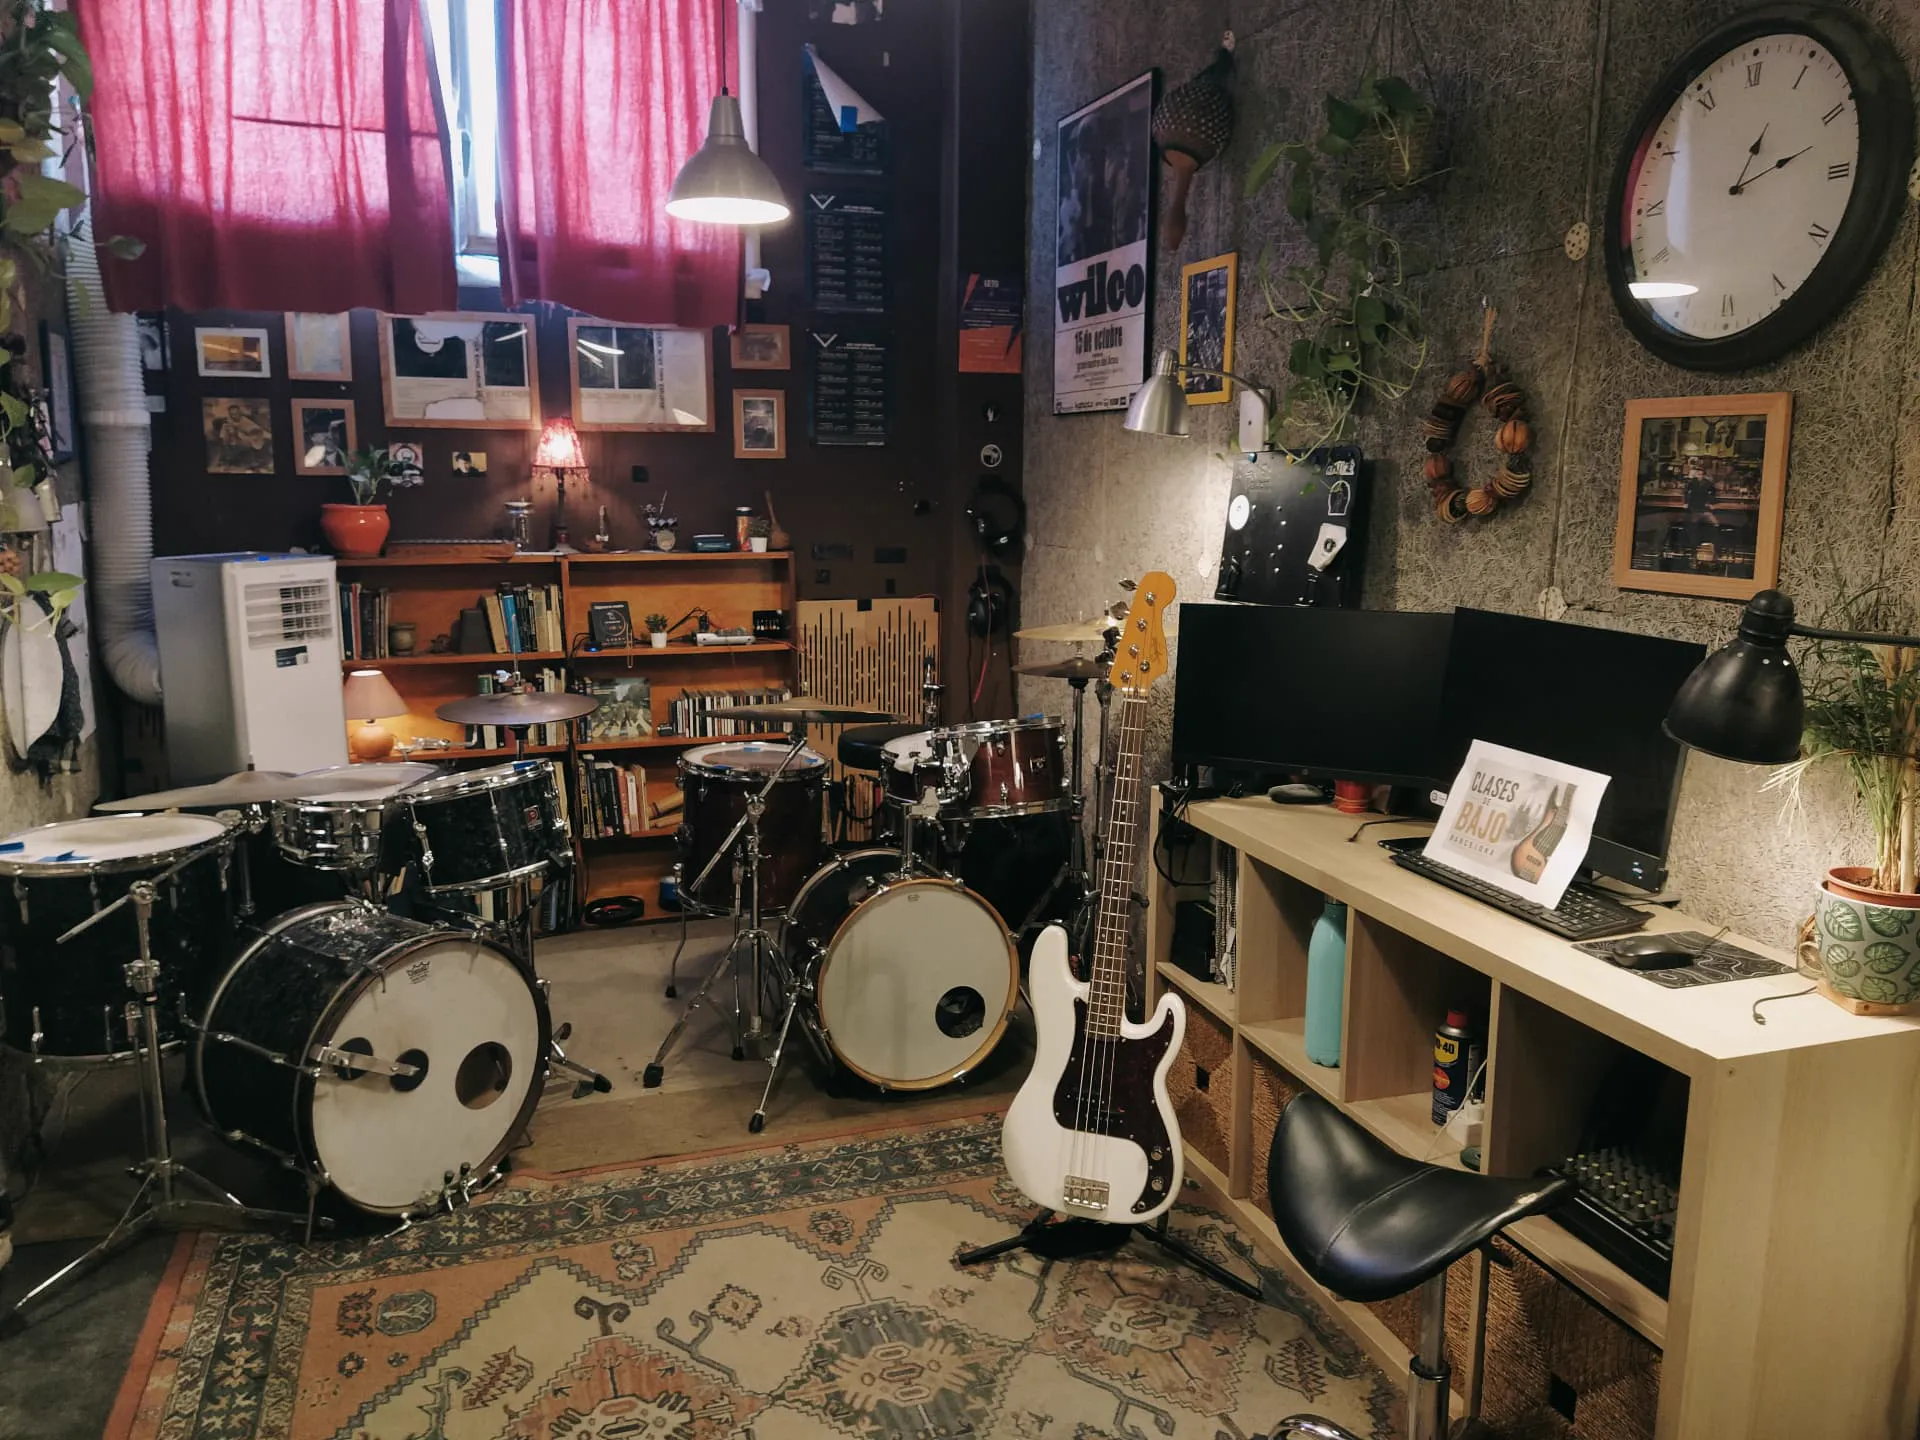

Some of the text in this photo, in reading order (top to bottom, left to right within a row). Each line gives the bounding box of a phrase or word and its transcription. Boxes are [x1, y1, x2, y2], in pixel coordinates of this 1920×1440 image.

[1057, 261, 1145, 323] wilco
[1075, 324, 1123, 354] 15 de octubre
[1471, 771, 1520, 803] CLASES
[1454, 800, 1508, 844] BAJO
[1449, 833, 1496, 857] BARCELONA
[1435, 1038, 1455, 1055] D-40
